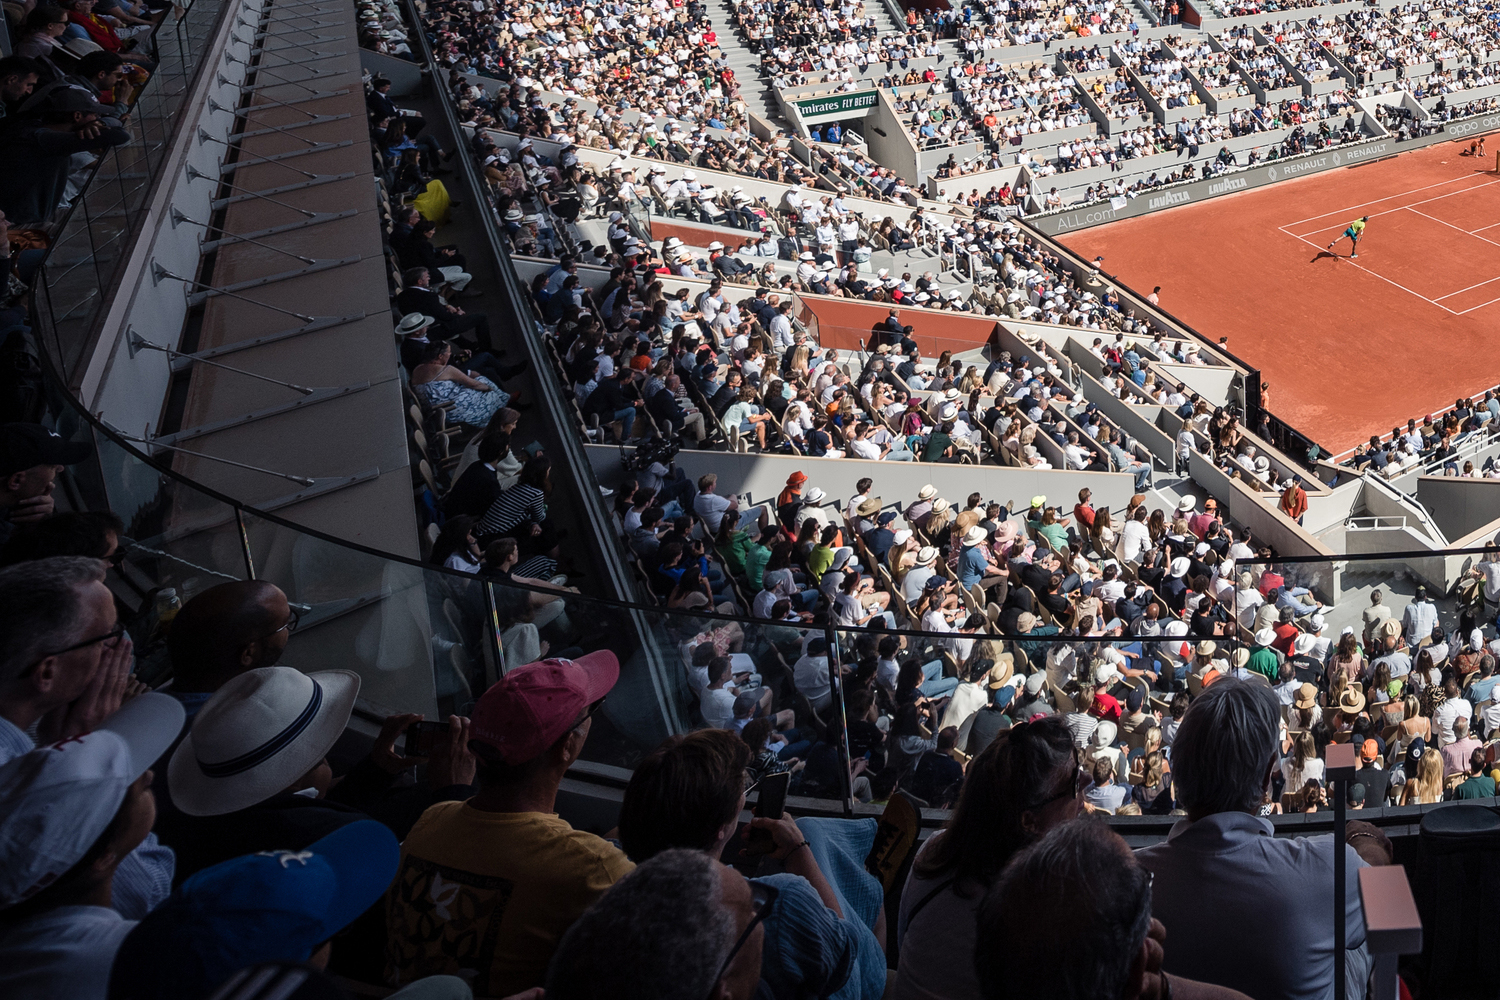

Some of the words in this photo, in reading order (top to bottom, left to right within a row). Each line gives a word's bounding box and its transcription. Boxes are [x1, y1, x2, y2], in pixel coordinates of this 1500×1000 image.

[842, 98, 853, 108] FLY
[1449, 121, 1479, 136] oppo
[1284, 158, 1326, 175] RENAULT
[1347, 144, 1387, 160] RENAULT
[1148, 191, 1190, 210] LAVAZZA
[1208, 177, 1247, 195] LAVAZZA
[1057, 208, 1116, 231] ALL.com
